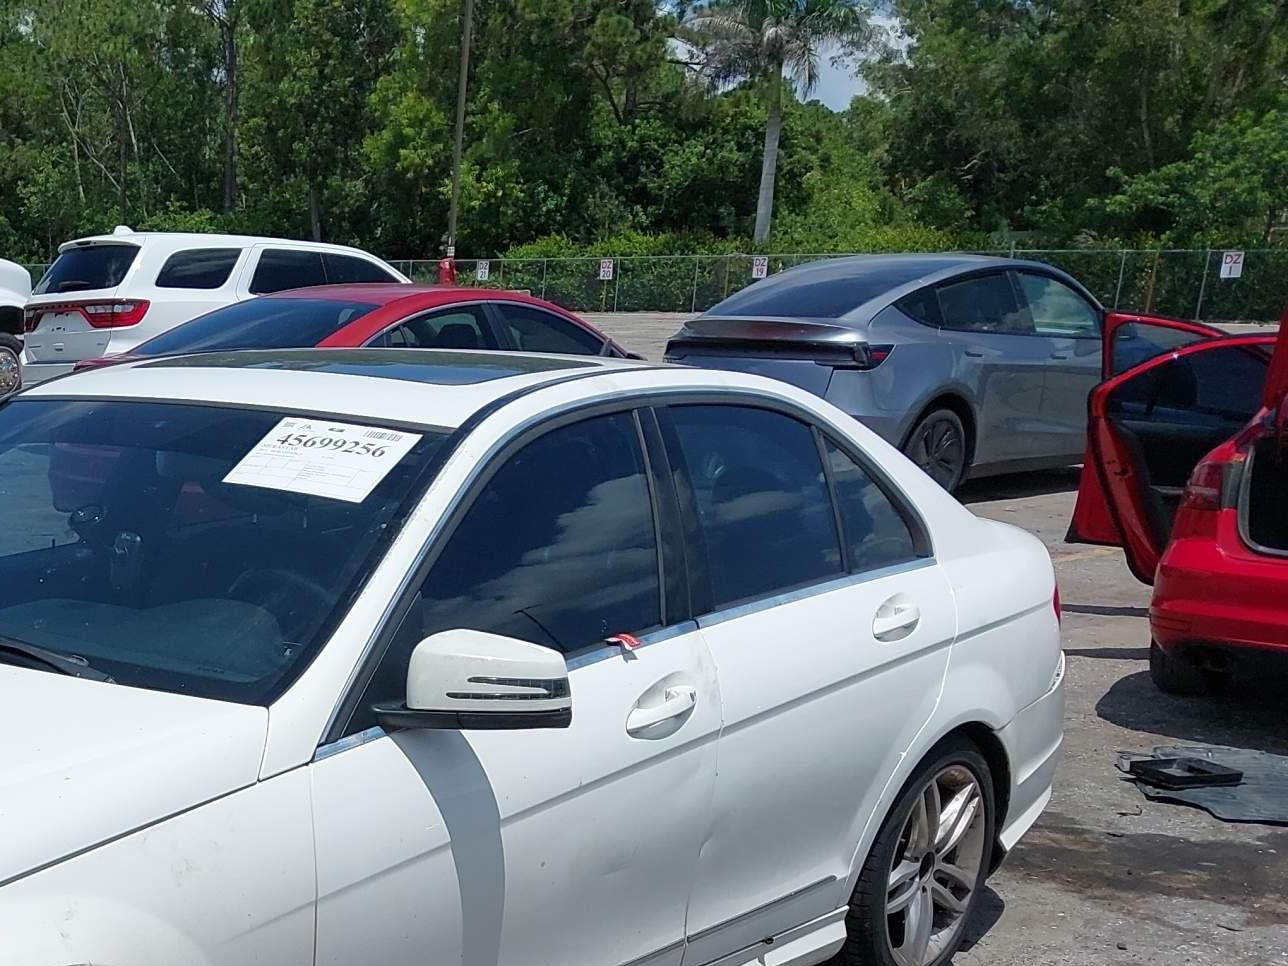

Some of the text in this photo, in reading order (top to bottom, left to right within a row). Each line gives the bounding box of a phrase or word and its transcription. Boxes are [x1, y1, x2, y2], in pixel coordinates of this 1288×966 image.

[754, 258, 767, 267] DZ
[1224, 253, 1242, 265] DZ
[601, 260, 612, 269] DZ
[601, 270, 611, 279] 20
[756, 268, 764, 276] 19
[276, 433, 392, 458] 45699256
